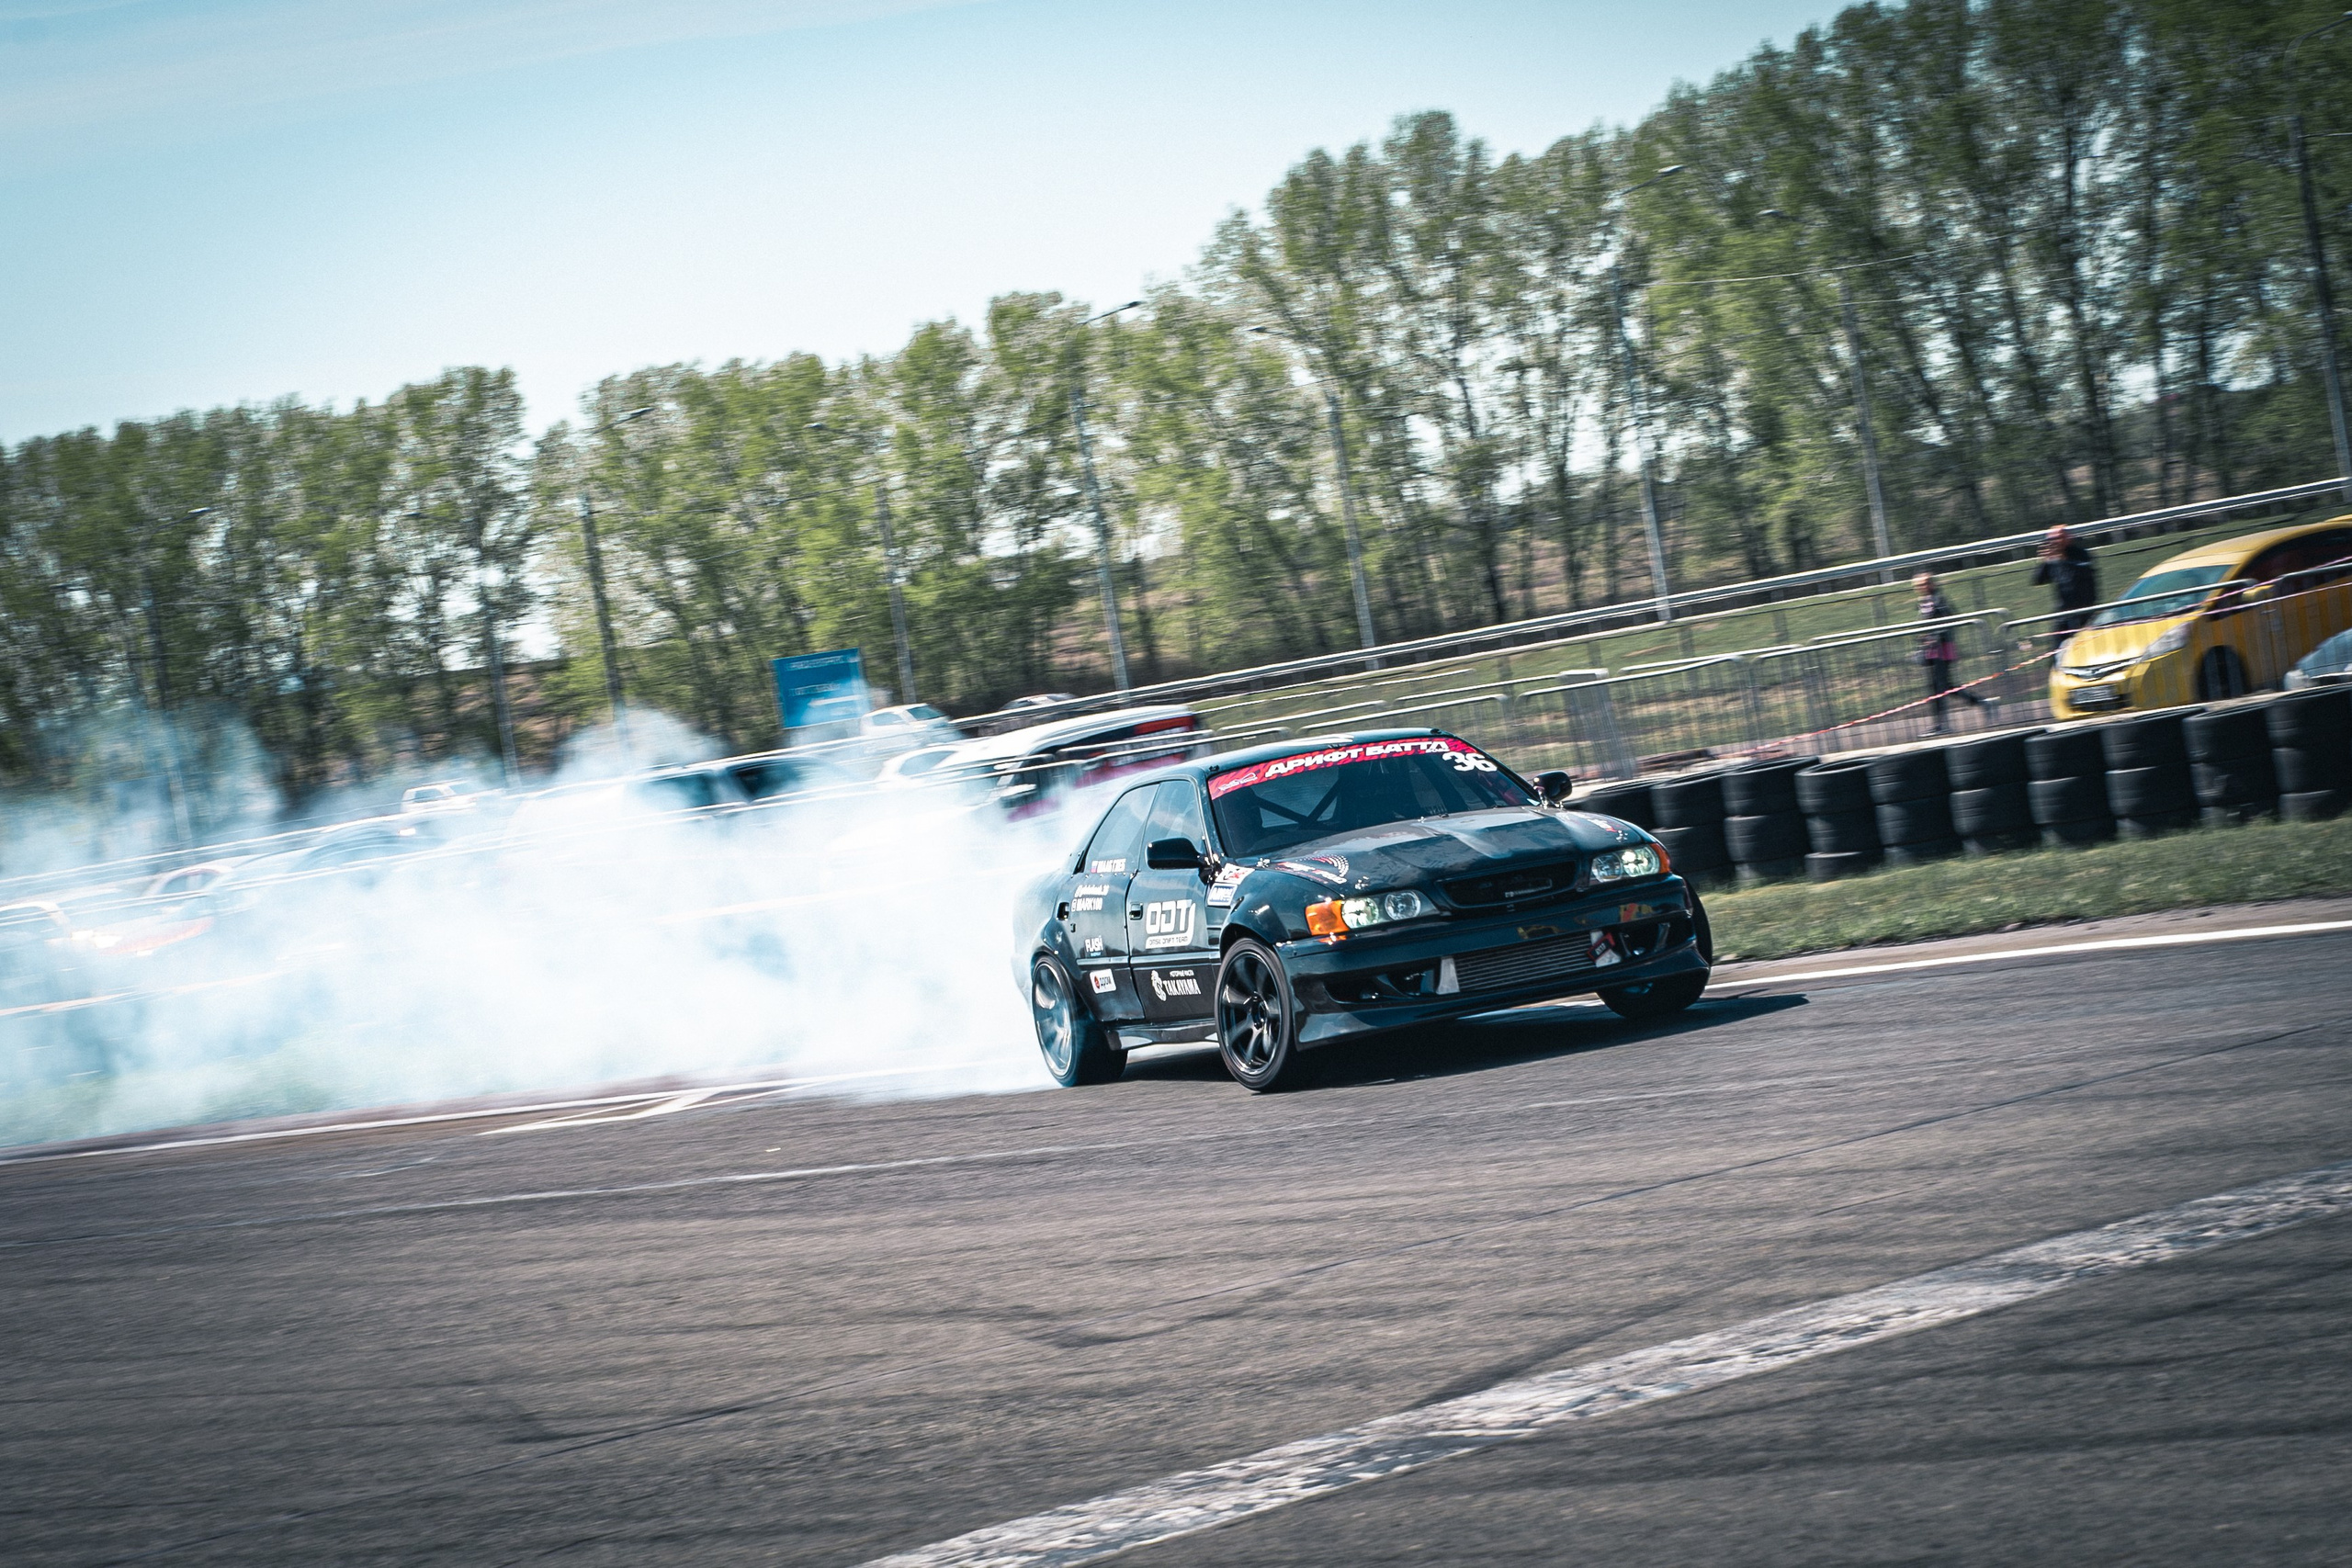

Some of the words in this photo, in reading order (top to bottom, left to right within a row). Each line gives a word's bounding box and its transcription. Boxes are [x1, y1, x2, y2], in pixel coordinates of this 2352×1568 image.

[1264, 748, 1363, 778] ДРИФТ
[1442, 751, 1498, 773] 36
[1146, 899, 1193, 934] ODT
[1162, 978, 1202, 996] TAKAYAMA
